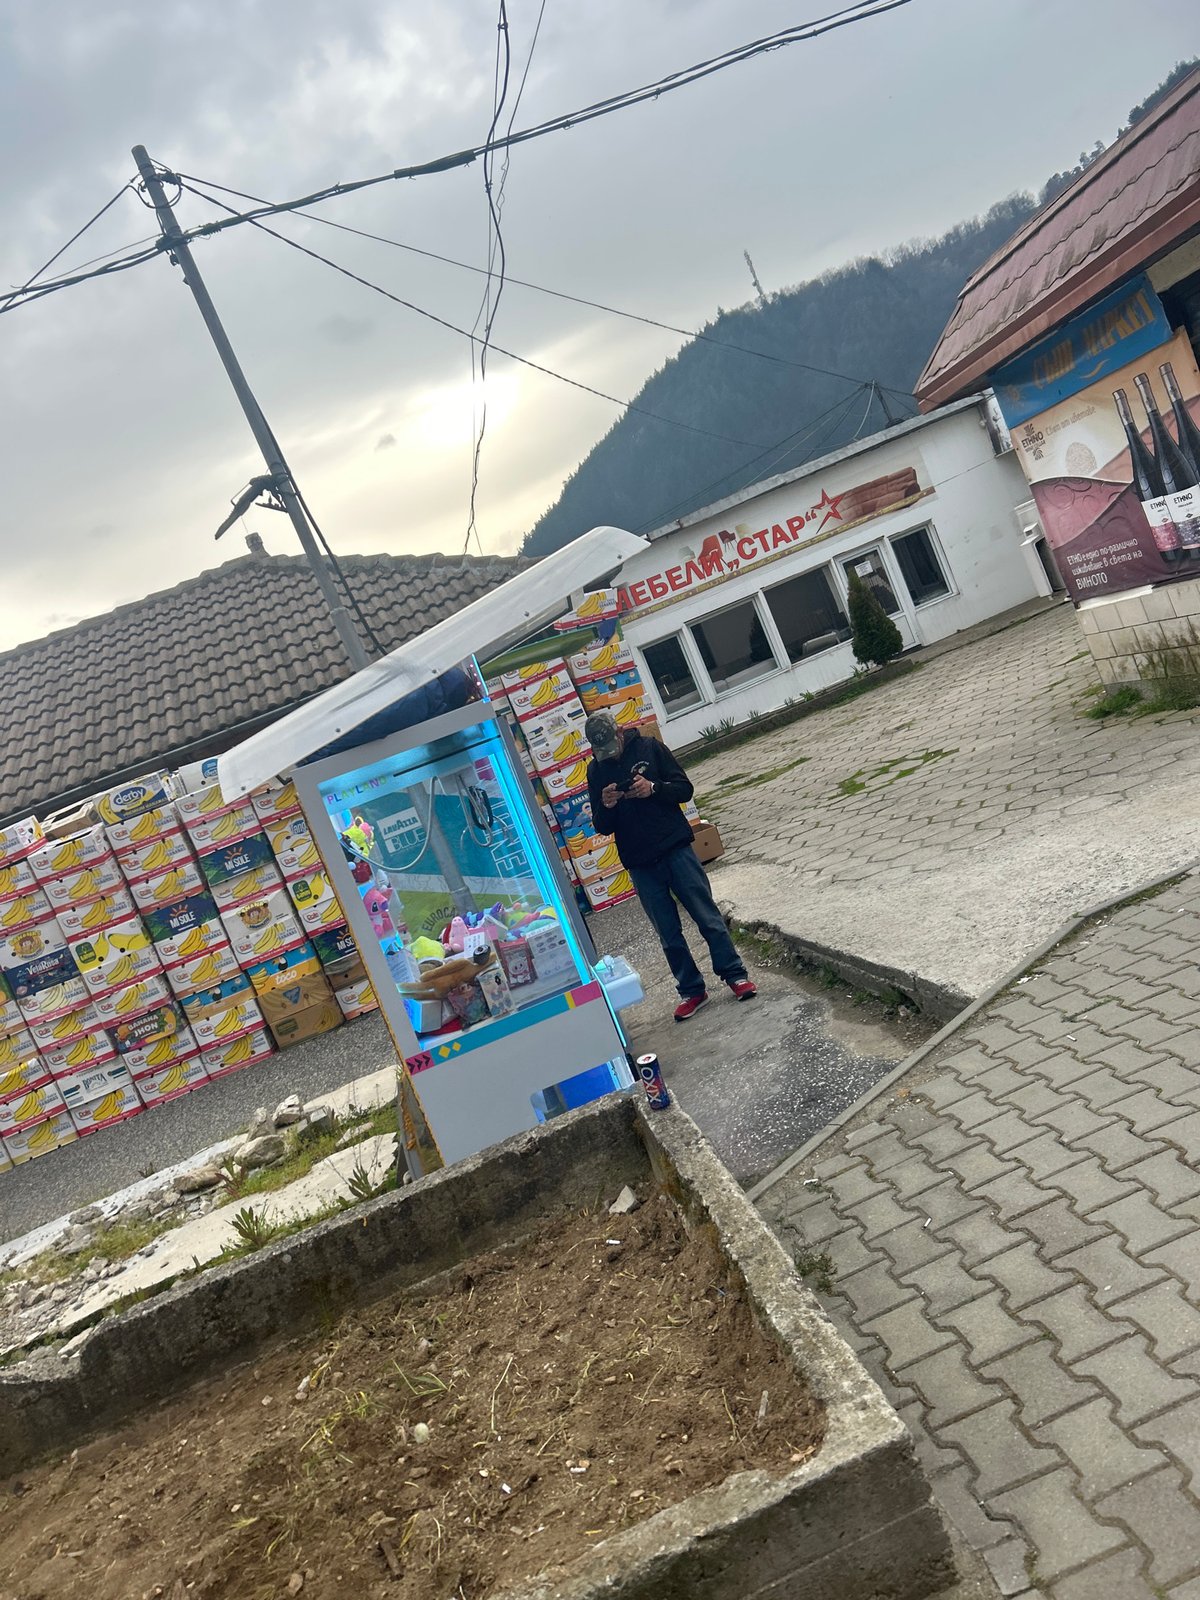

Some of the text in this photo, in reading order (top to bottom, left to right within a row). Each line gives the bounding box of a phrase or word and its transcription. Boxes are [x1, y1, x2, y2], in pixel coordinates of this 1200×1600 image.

[1022, 432, 1044, 448] ETHNO
[1174, 492, 1193, 504] ETHNO
[1100, 538, 1138, 554] по-различно
[1110, 552, 1132, 566] света
[1134, 550, 1143, 559] на
[1076, 572, 1108, 590] ВИНОТО
[115, 788, 144, 806] derby
[326, 776, 388, 804] PLAYLAND
[383, 816, 418, 835] LAVAZZA
[391, 828, 426, 851] BLUE
[234, 854, 250, 868] SOLE
[179, 912, 196, 926] SOLE
[276, 970, 298, 984] toco
[128, 1014, 159, 1030] BANANA
[134, 1022, 158, 1037] JHON
[82, 1072, 108, 1090] BONITA
[641, 1067, 662, 1102] XIXO
